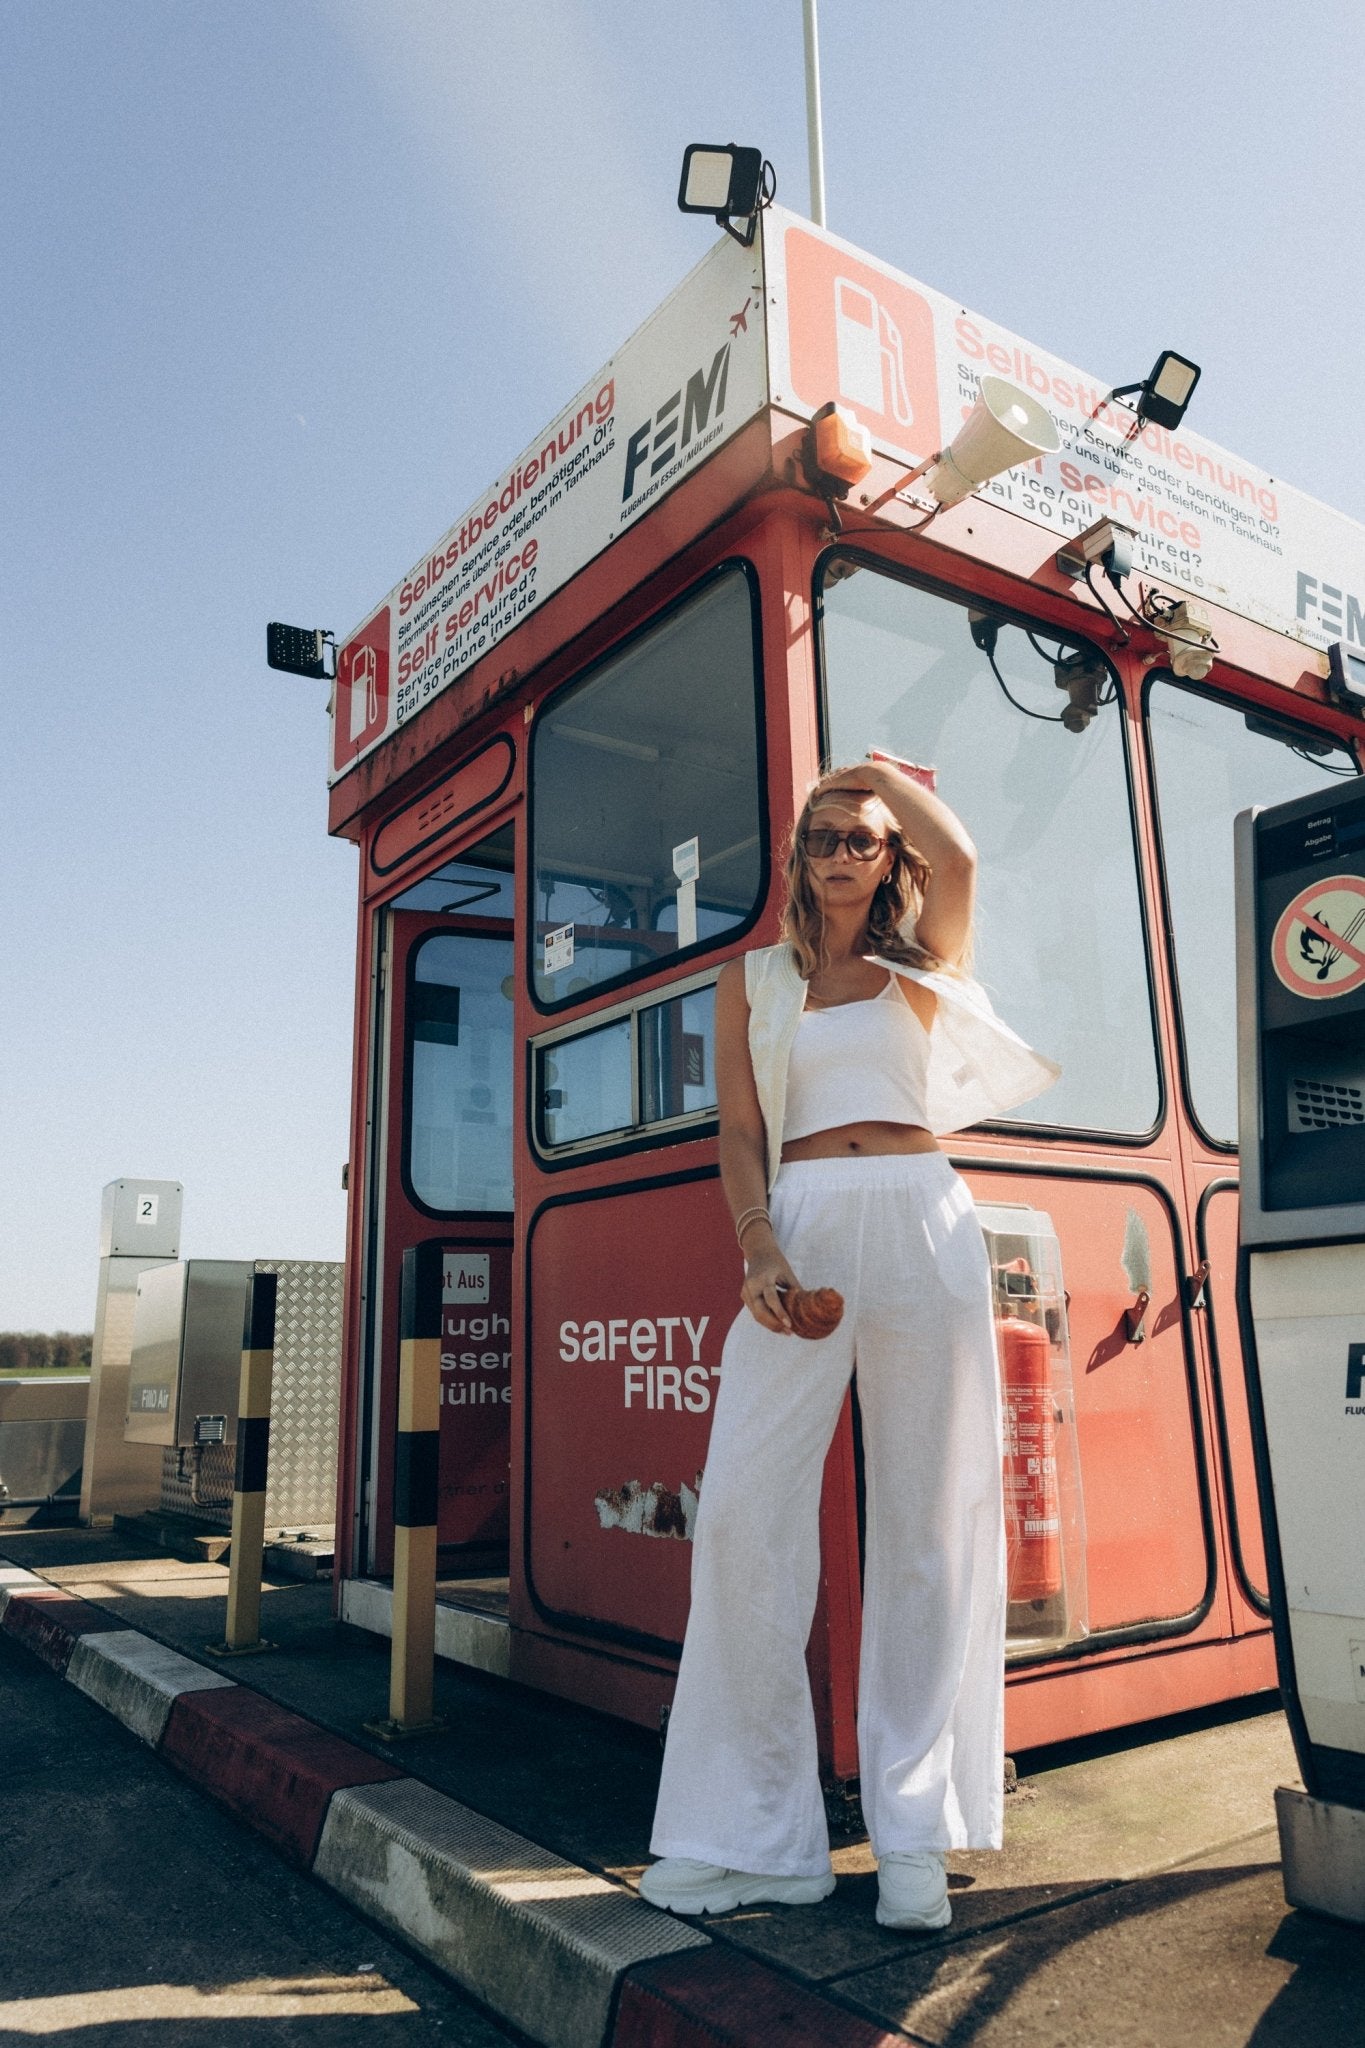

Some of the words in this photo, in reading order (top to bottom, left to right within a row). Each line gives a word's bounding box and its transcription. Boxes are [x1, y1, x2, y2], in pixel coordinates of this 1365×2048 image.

[622, 341, 731, 504] FEM
[955, 318, 1279, 522] Selbstbedienung
[398, 621, 412, 640] Sie
[413, 574, 460, 624] wünschen
[461, 534, 499, 578] Service
[502, 503, 528, 536] oder
[530, 443, 590, 510] benötigen
[593, 416, 615, 447] Öl?
[400, 377, 615, 616] Selbstbedienung
[620, 480, 660, 522] FLUGHAFEN
[991, 482, 1012, 501] al
[1022, 493, 1053, 518] 30
[1141, 548, 1205, 588] inside
[1008, 468, 1092, 518] vice/oil
[1138, 531, 1202, 568] uired?
[1060, 461, 1200, 550] service
[1076, 444, 1100, 464] uns
[1104, 456, 1134, 481] über
[1138, 476, 1162, 495] das
[1165, 488, 1209, 520] Telefon
[1212, 512, 1227, 528] im
[1228, 520, 1283, 556] Tankhaus
[1084, 428, 1143, 470] Service
[1148, 464, 1182, 488] oder
[1186, 481, 1256, 528] benötigen
[1258, 516, 1280, 539] Öl?
[398, 610, 440, 654] Informieren
[442, 594, 454, 612] Sie
[455, 580, 470, 602] uns
[472, 557, 493, 582] über
[495, 541, 511, 560] das
[513, 504, 548, 542] Telefon
[550, 489, 562, 508] im
[564, 438, 616, 492] Tankhaus
[396, 690, 419, 721] Dial
[422, 674, 439, 698] 30
[443, 634, 486, 680] Phone
[490, 588, 537, 638] inside
[397, 636, 463, 704] Service/oil
[466, 566, 538, 642] required?
[398, 622, 440, 686] Self
[445, 539, 538, 642] service
[1304, 834, 1332, 848] Abgabe
[1308, 817, 1332, 828] Betrag
[142, 1201, 152, 1216] 2
[457, 1270, 485, 1289] Aus
